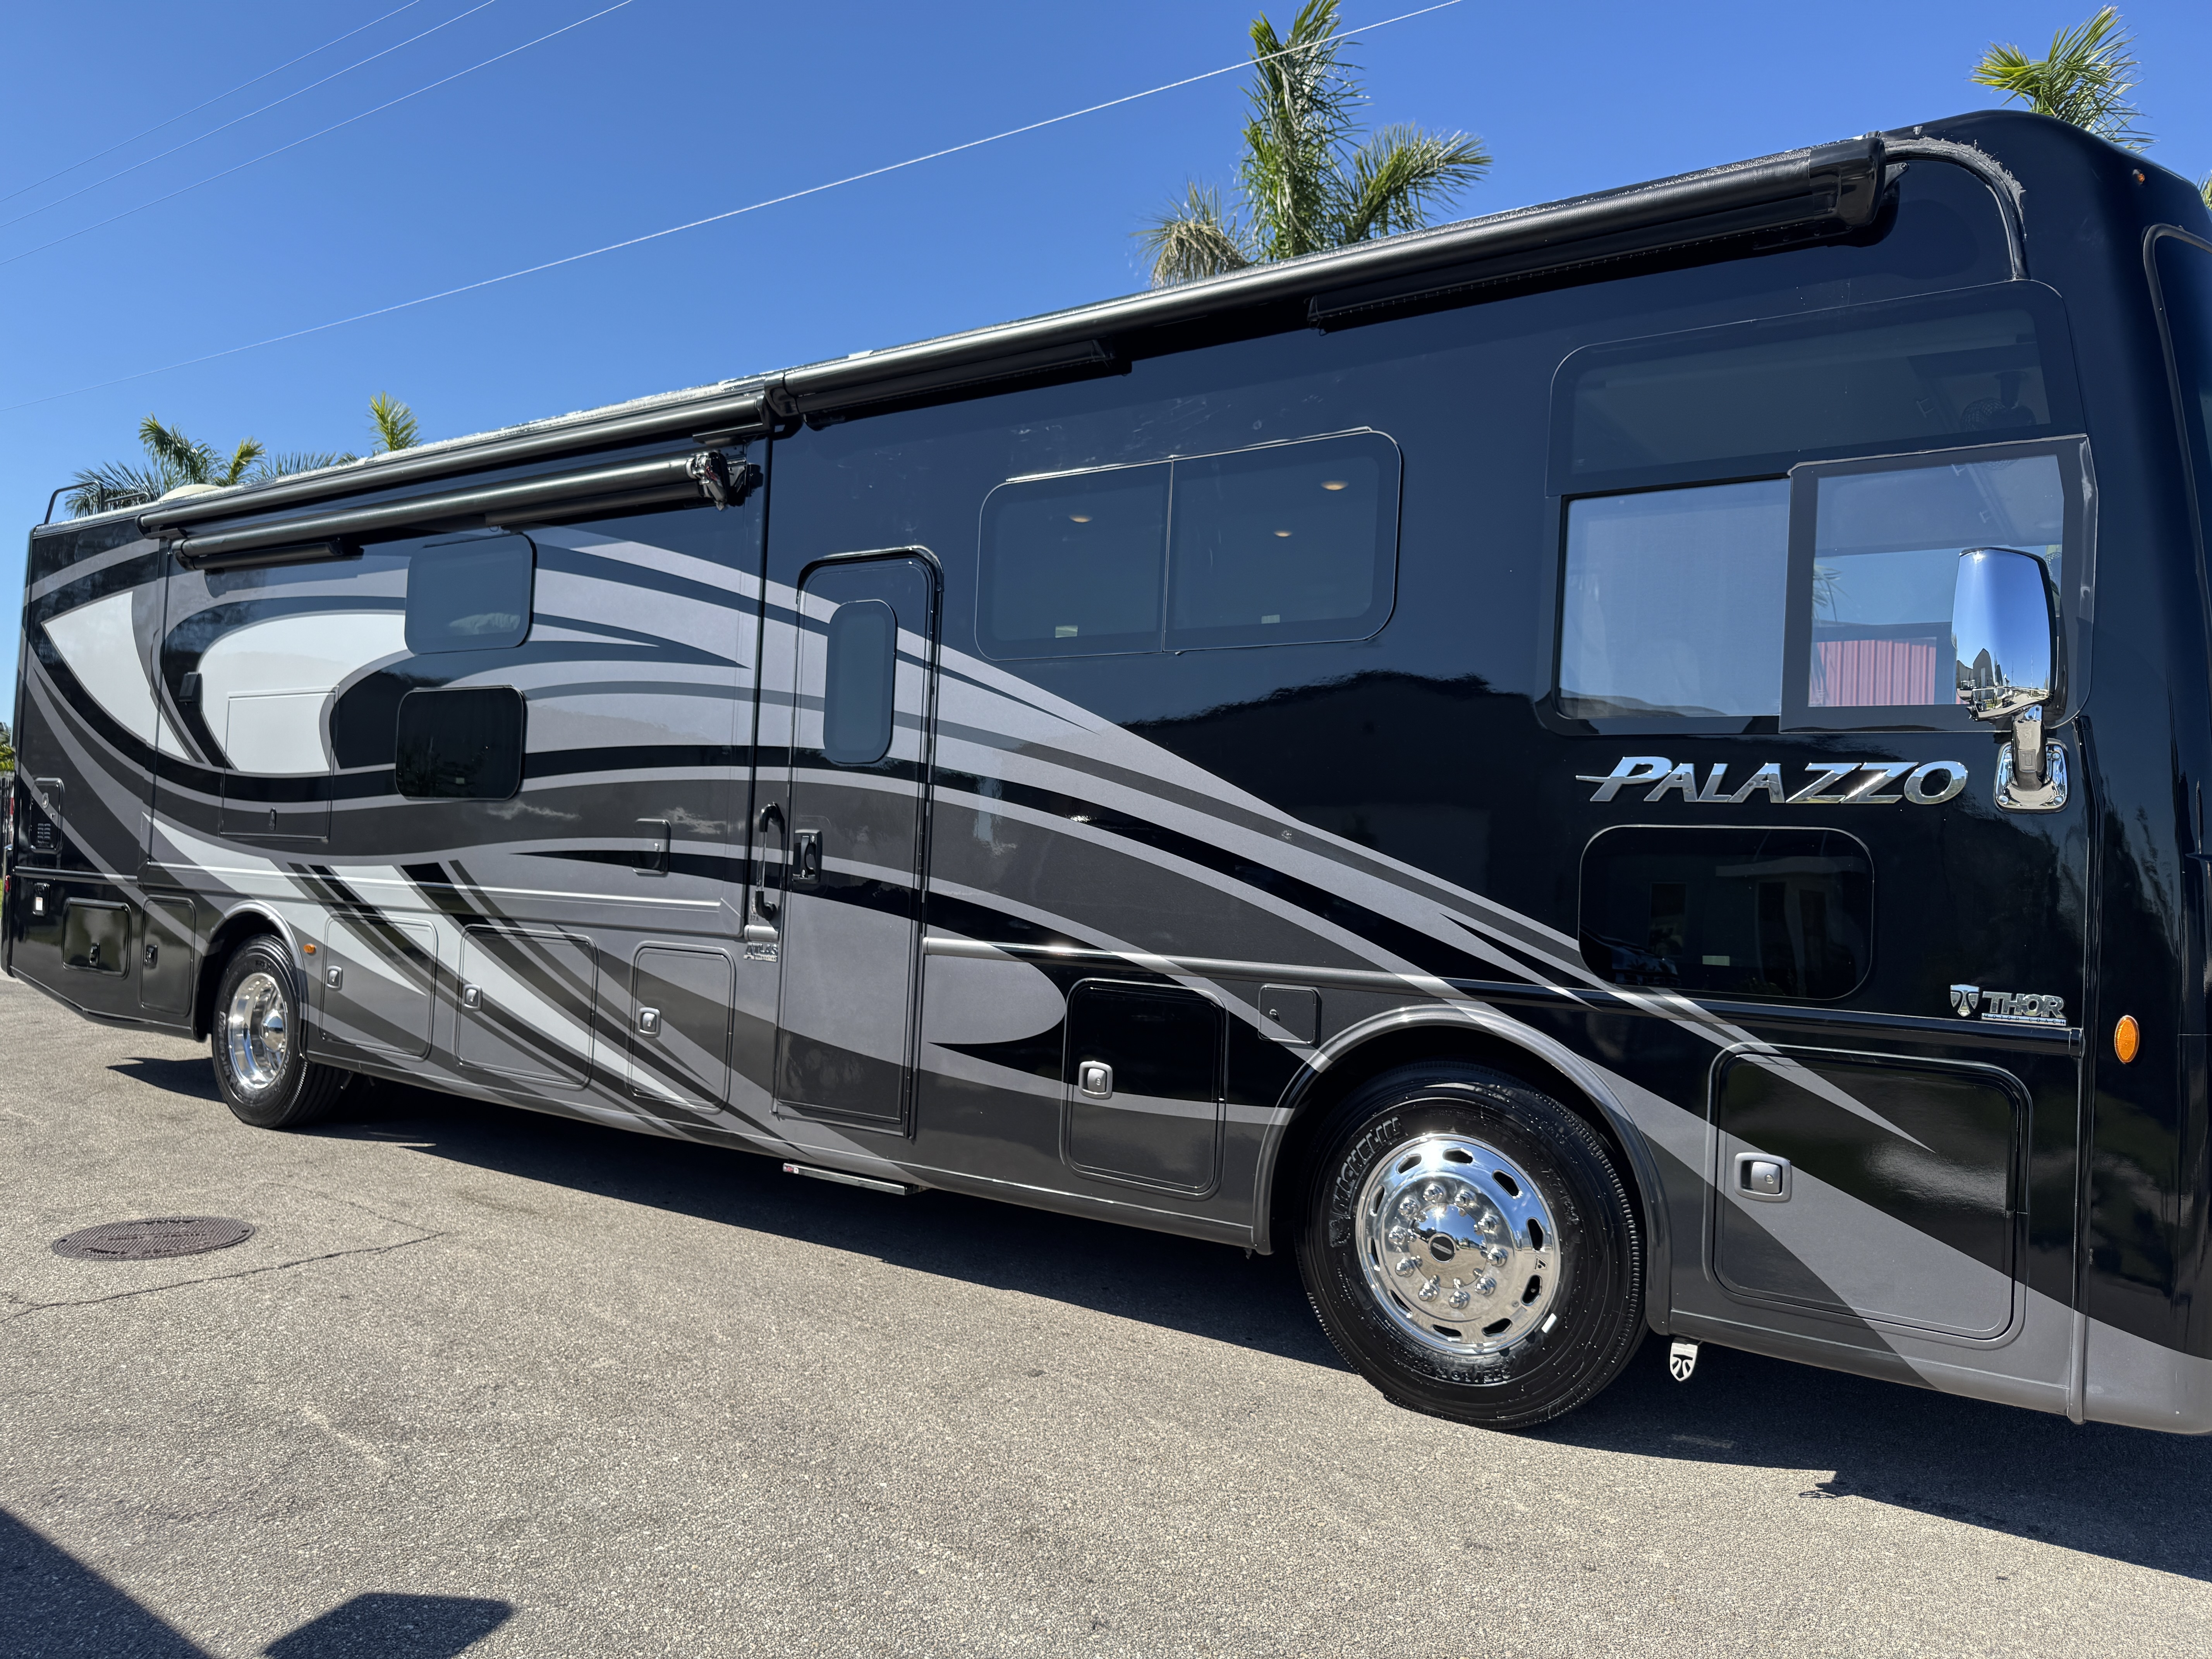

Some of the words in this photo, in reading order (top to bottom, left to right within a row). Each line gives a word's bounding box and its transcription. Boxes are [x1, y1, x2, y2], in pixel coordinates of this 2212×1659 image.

[1575, 756, 1968, 805] PALAZZO
[745, 942, 778, 955] ATLAS
[1982, 991, 2067, 1019] THOR
[1331, 1115, 1408, 1217] MICHELIN
